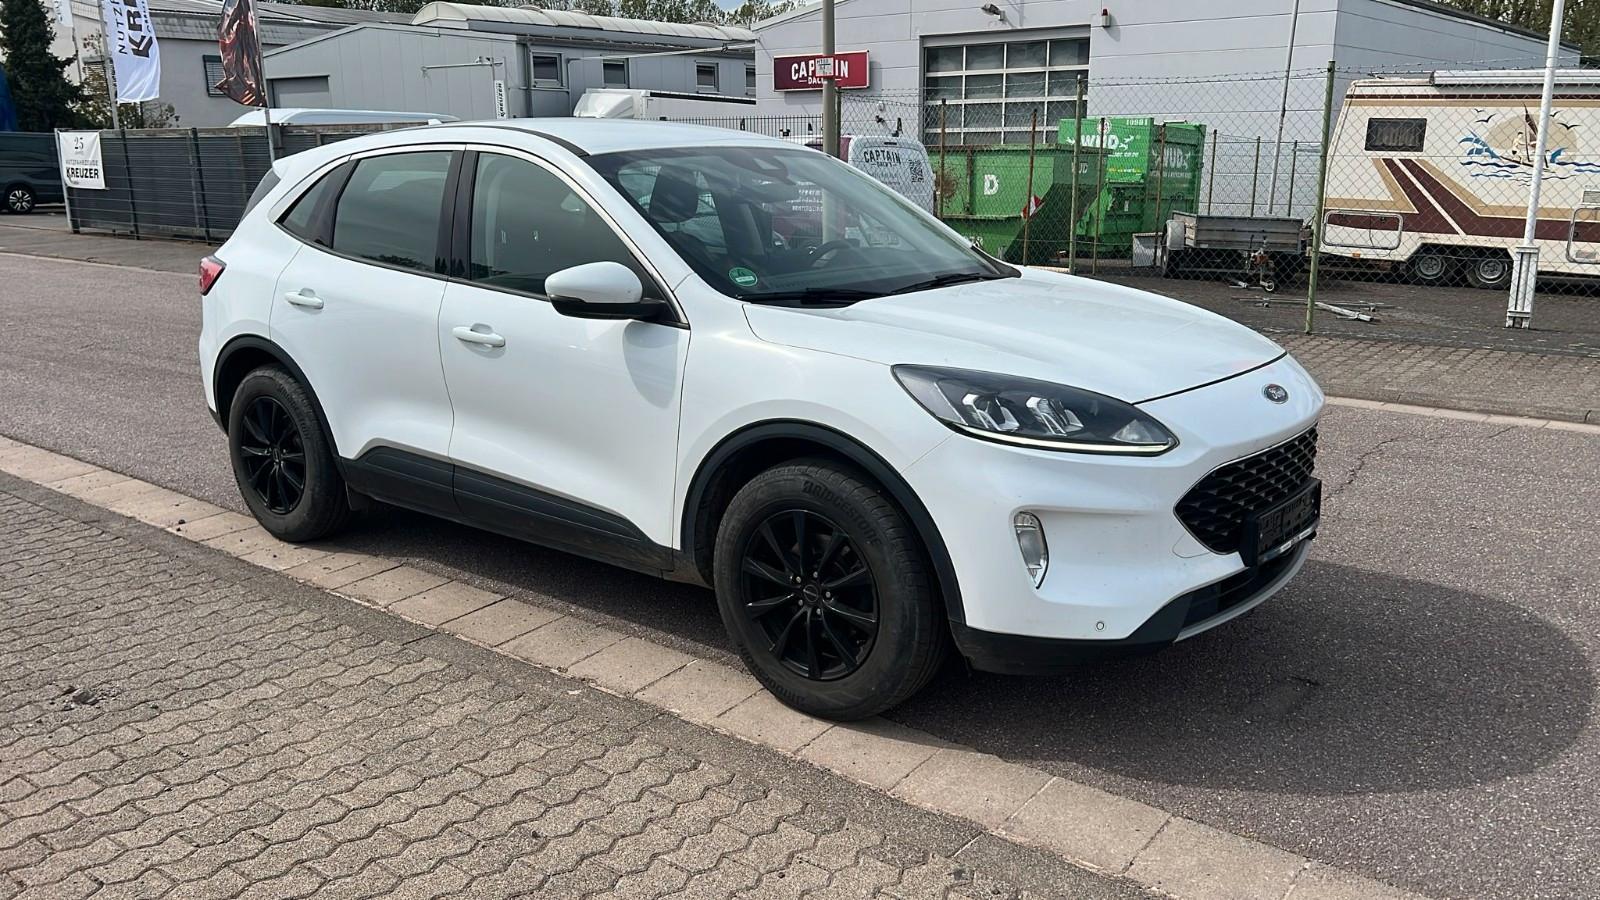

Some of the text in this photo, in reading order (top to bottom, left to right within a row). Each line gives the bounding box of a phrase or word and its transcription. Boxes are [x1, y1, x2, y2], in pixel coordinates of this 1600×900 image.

[791, 60, 849, 80] CAPIN
[74, 136, 84, 150] 25
[863, 149, 901, 165] CAPTAIN
[66, 167, 99, 179] KREUZER
[984, 174, 999, 195] D
[801, 480, 882, 545] BRIDGESTONE
